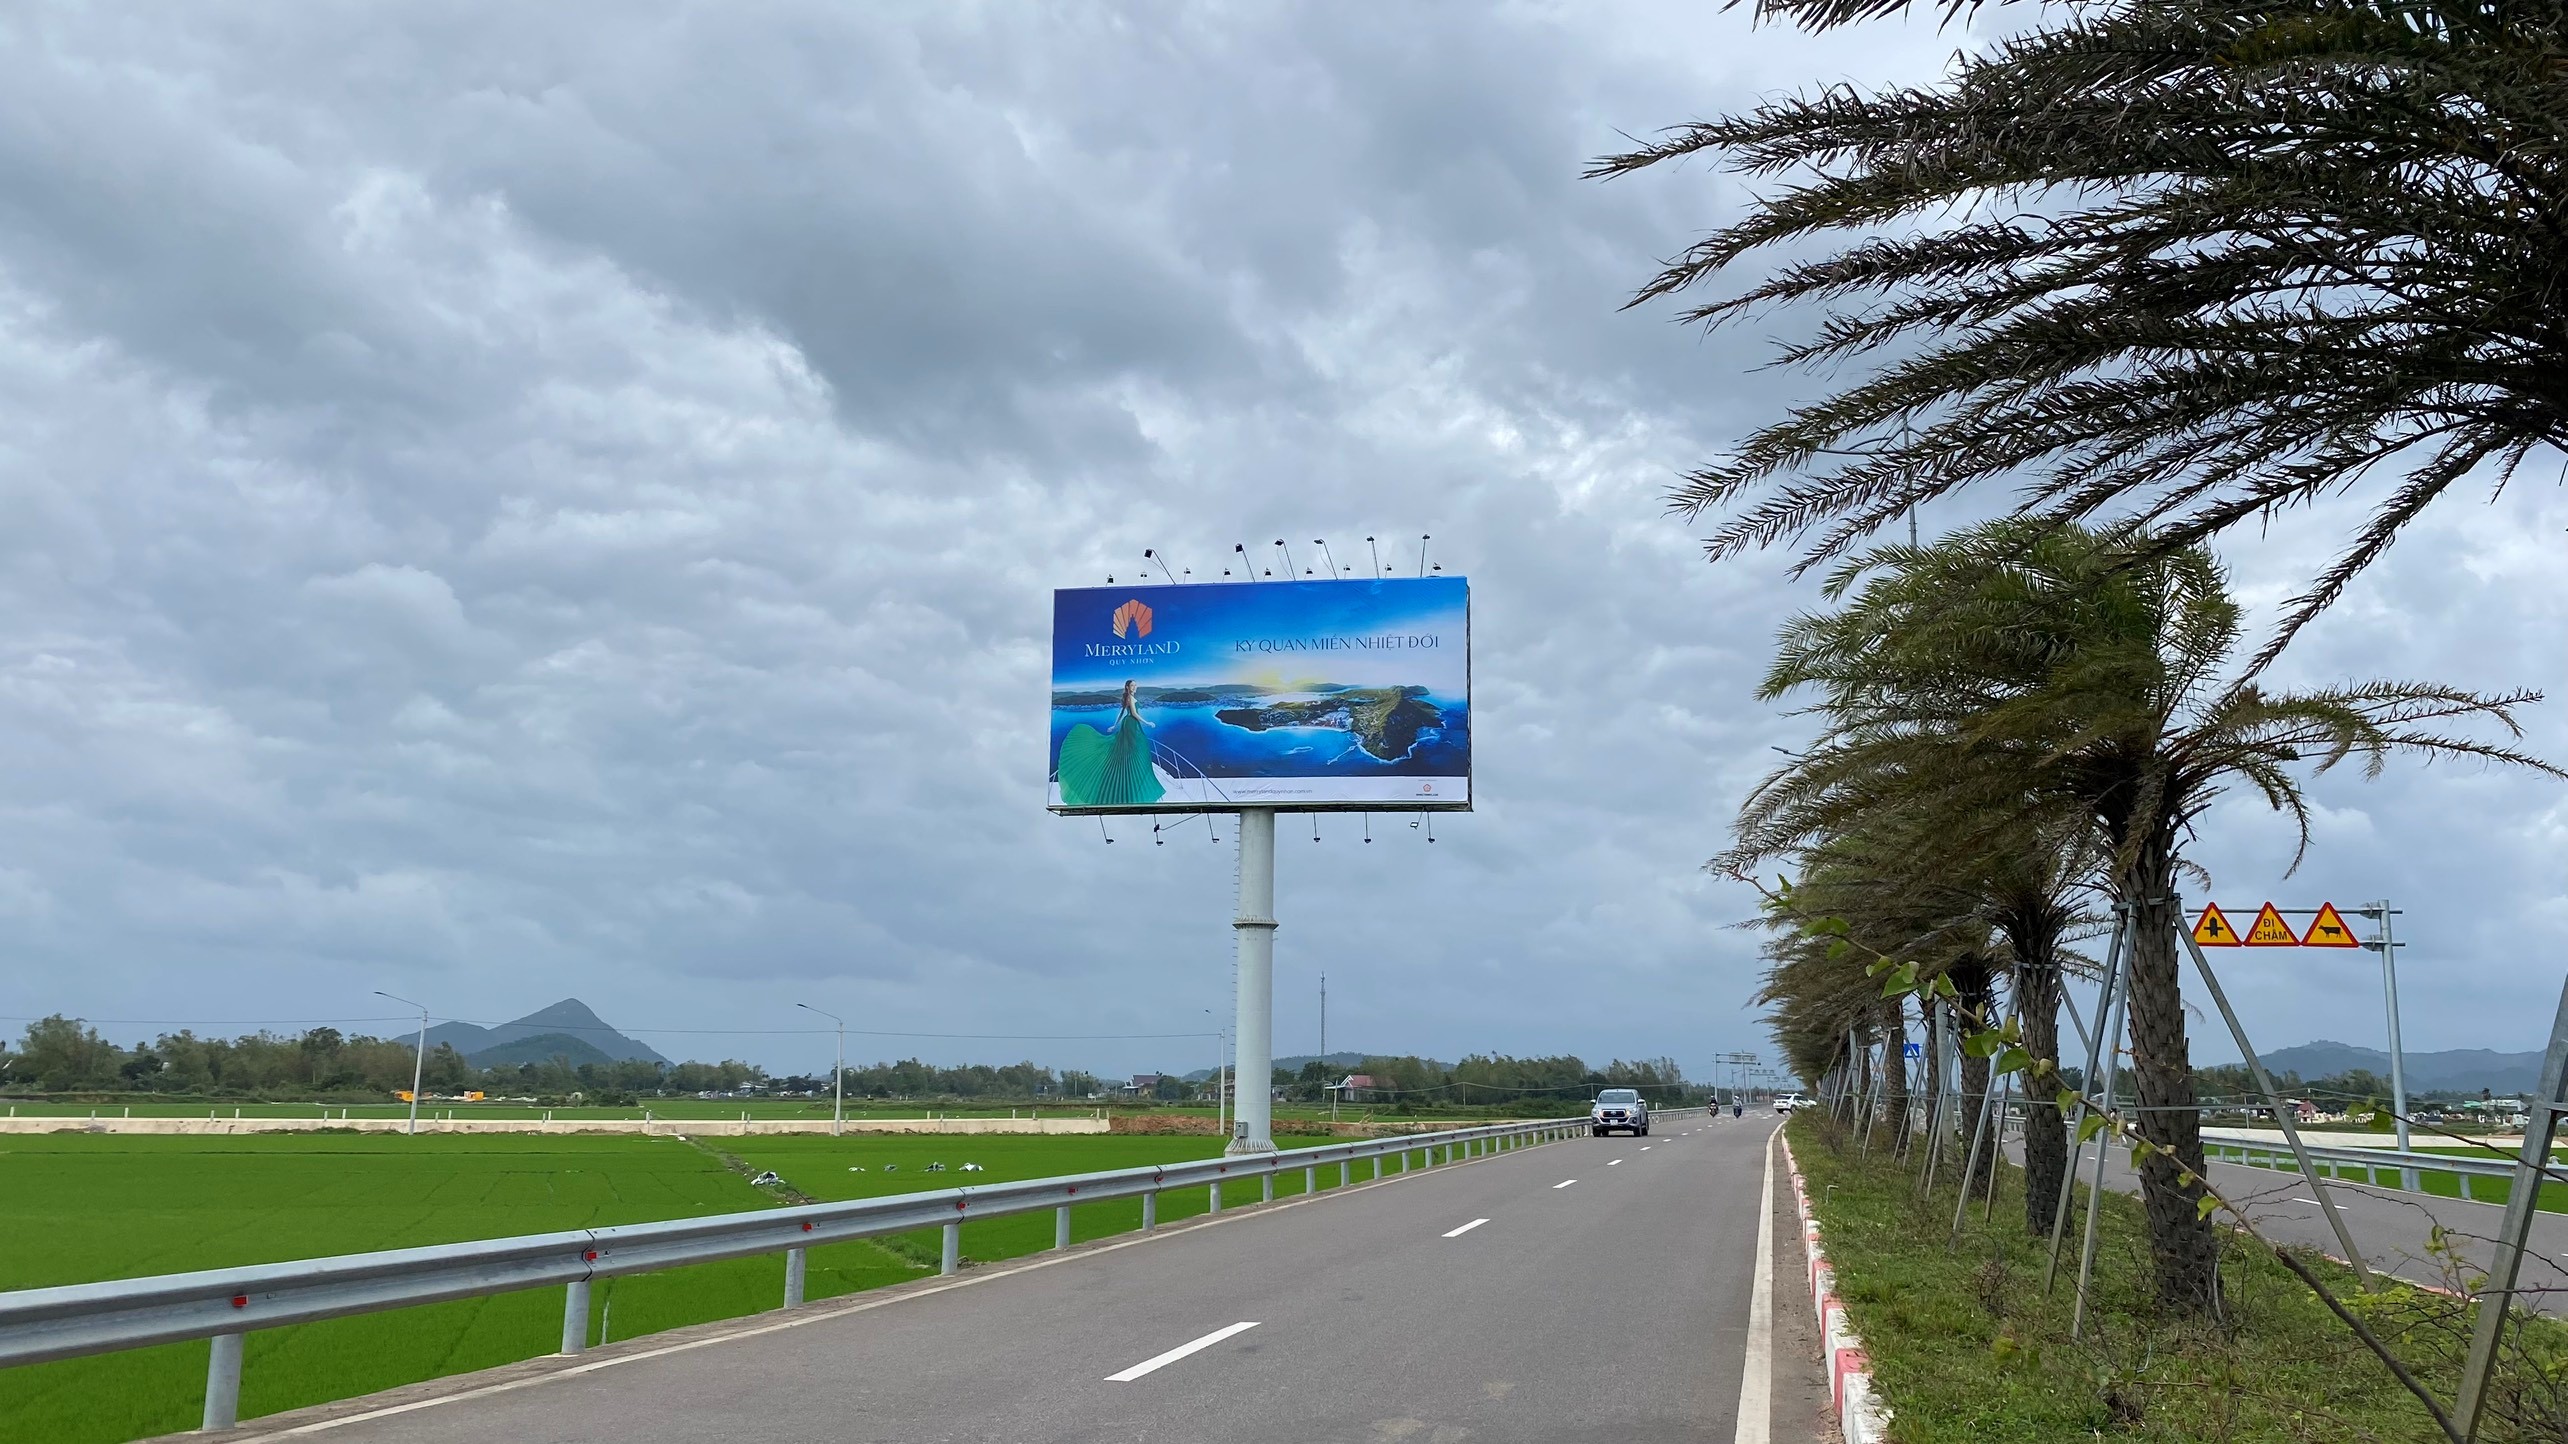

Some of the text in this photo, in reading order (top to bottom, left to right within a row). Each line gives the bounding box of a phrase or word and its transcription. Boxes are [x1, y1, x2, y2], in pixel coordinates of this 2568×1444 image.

[1084, 640, 1180, 657] MERRYLAND
[1258, 639, 1307, 653] QUAN
[1355, 633, 1404, 650] NHIỆT
[1407, 633, 1438, 648] ĐỚI
[2263, 918, 2275, 928] ĐI
[2254, 929, 2288, 941] CHẬM
